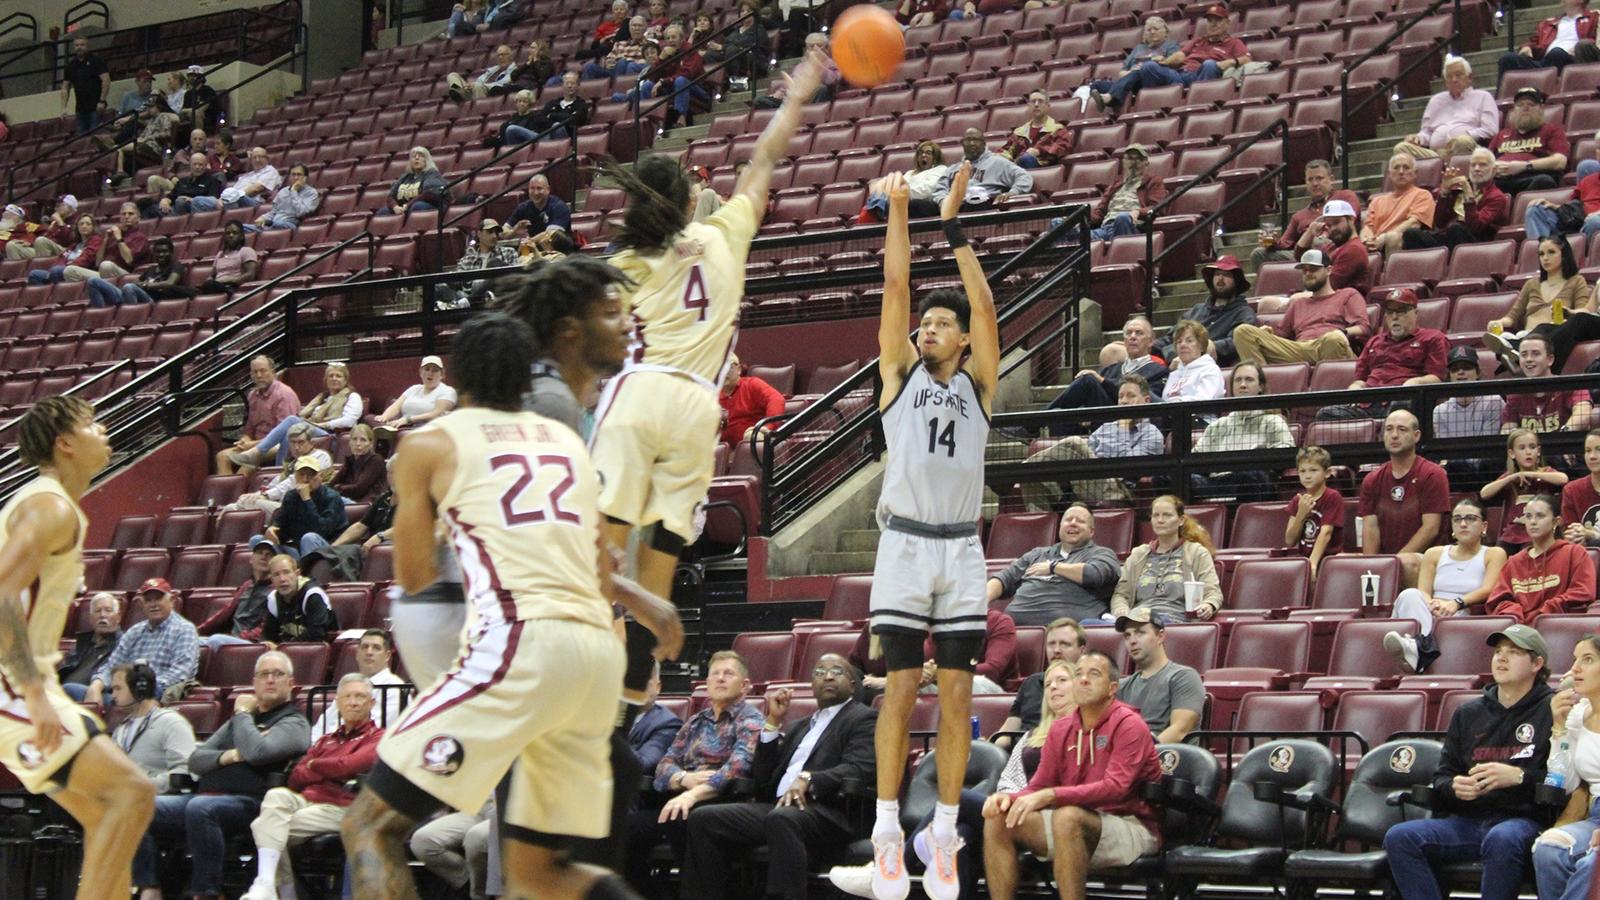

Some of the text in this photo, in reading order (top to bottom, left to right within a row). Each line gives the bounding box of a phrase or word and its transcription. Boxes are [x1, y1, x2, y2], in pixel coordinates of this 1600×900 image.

[683, 265, 710, 321] 4
[928, 417, 956, 457] 14
[489, 453, 581, 526] 22
